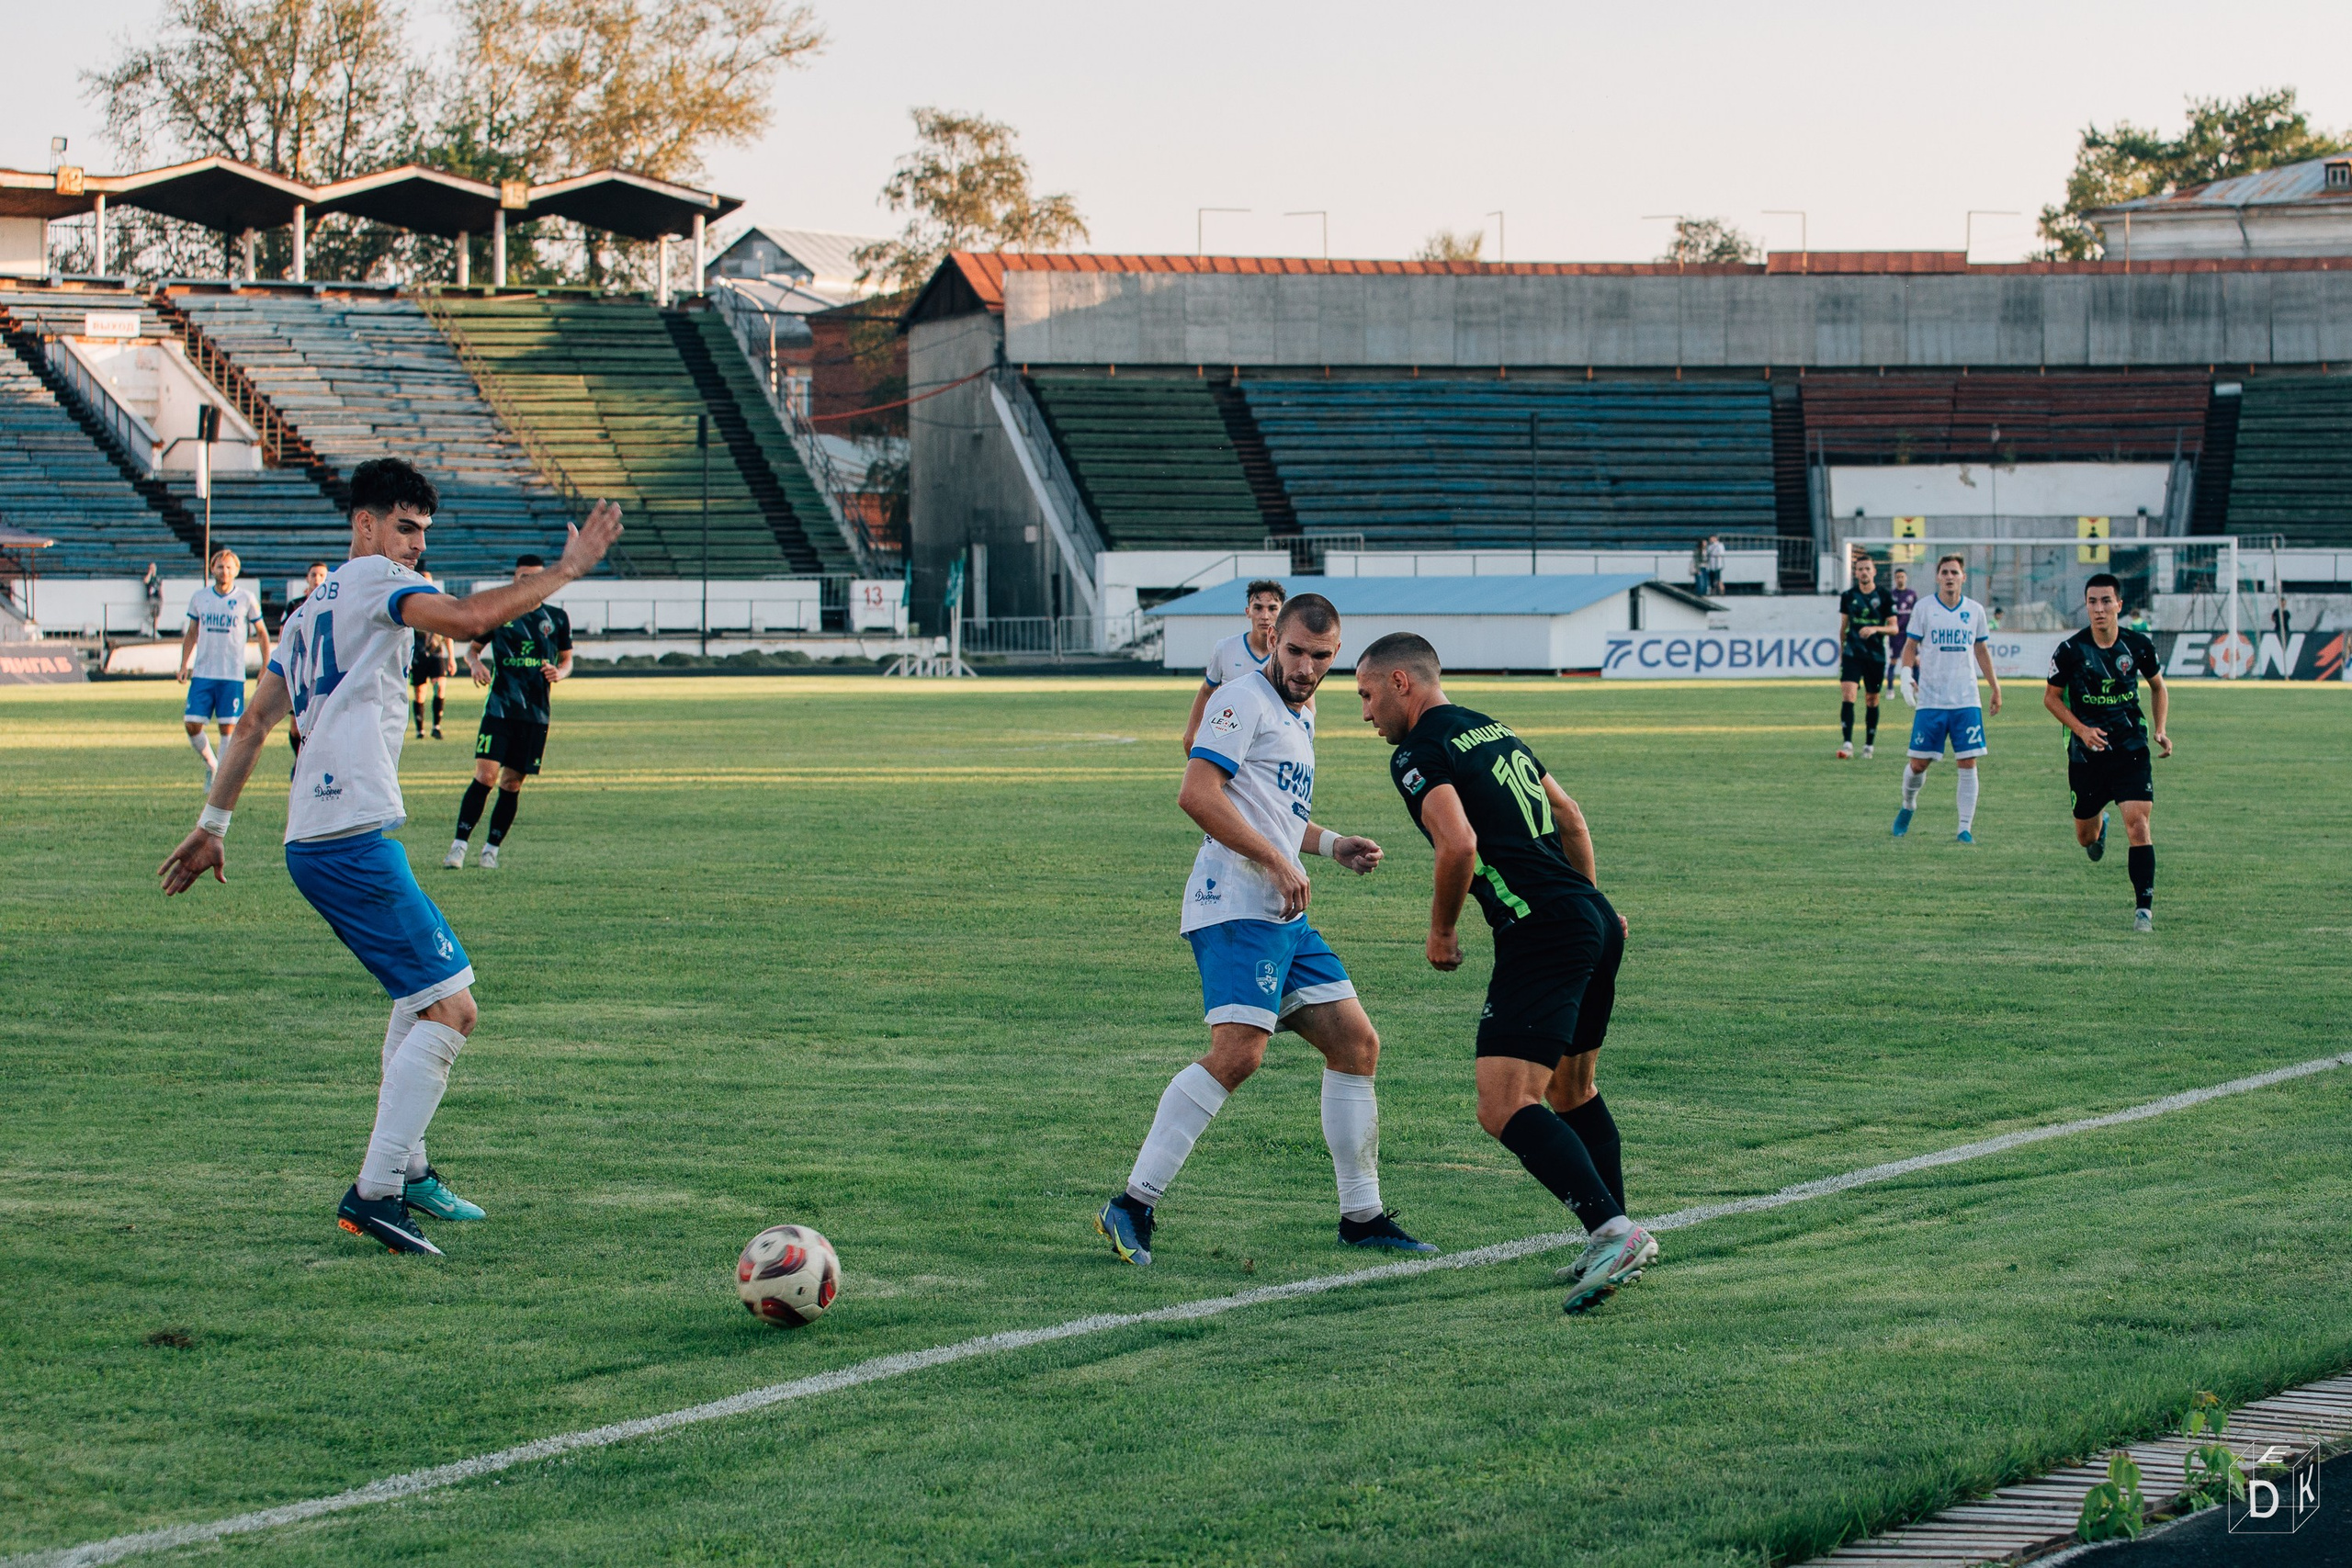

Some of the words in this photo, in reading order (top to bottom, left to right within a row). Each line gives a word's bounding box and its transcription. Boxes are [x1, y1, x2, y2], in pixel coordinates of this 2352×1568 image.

[93, 321, 134, 333] ВЫХОД
[865, 586, 883, 606] 13
[1638, 637, 1840, 672] сервико
[232, 697, 240, 713] 9
[2082, 691, 2134, 705] сервико
[476, 734, 492, 753] 21
[1491, 749, 1555, 839] 19
